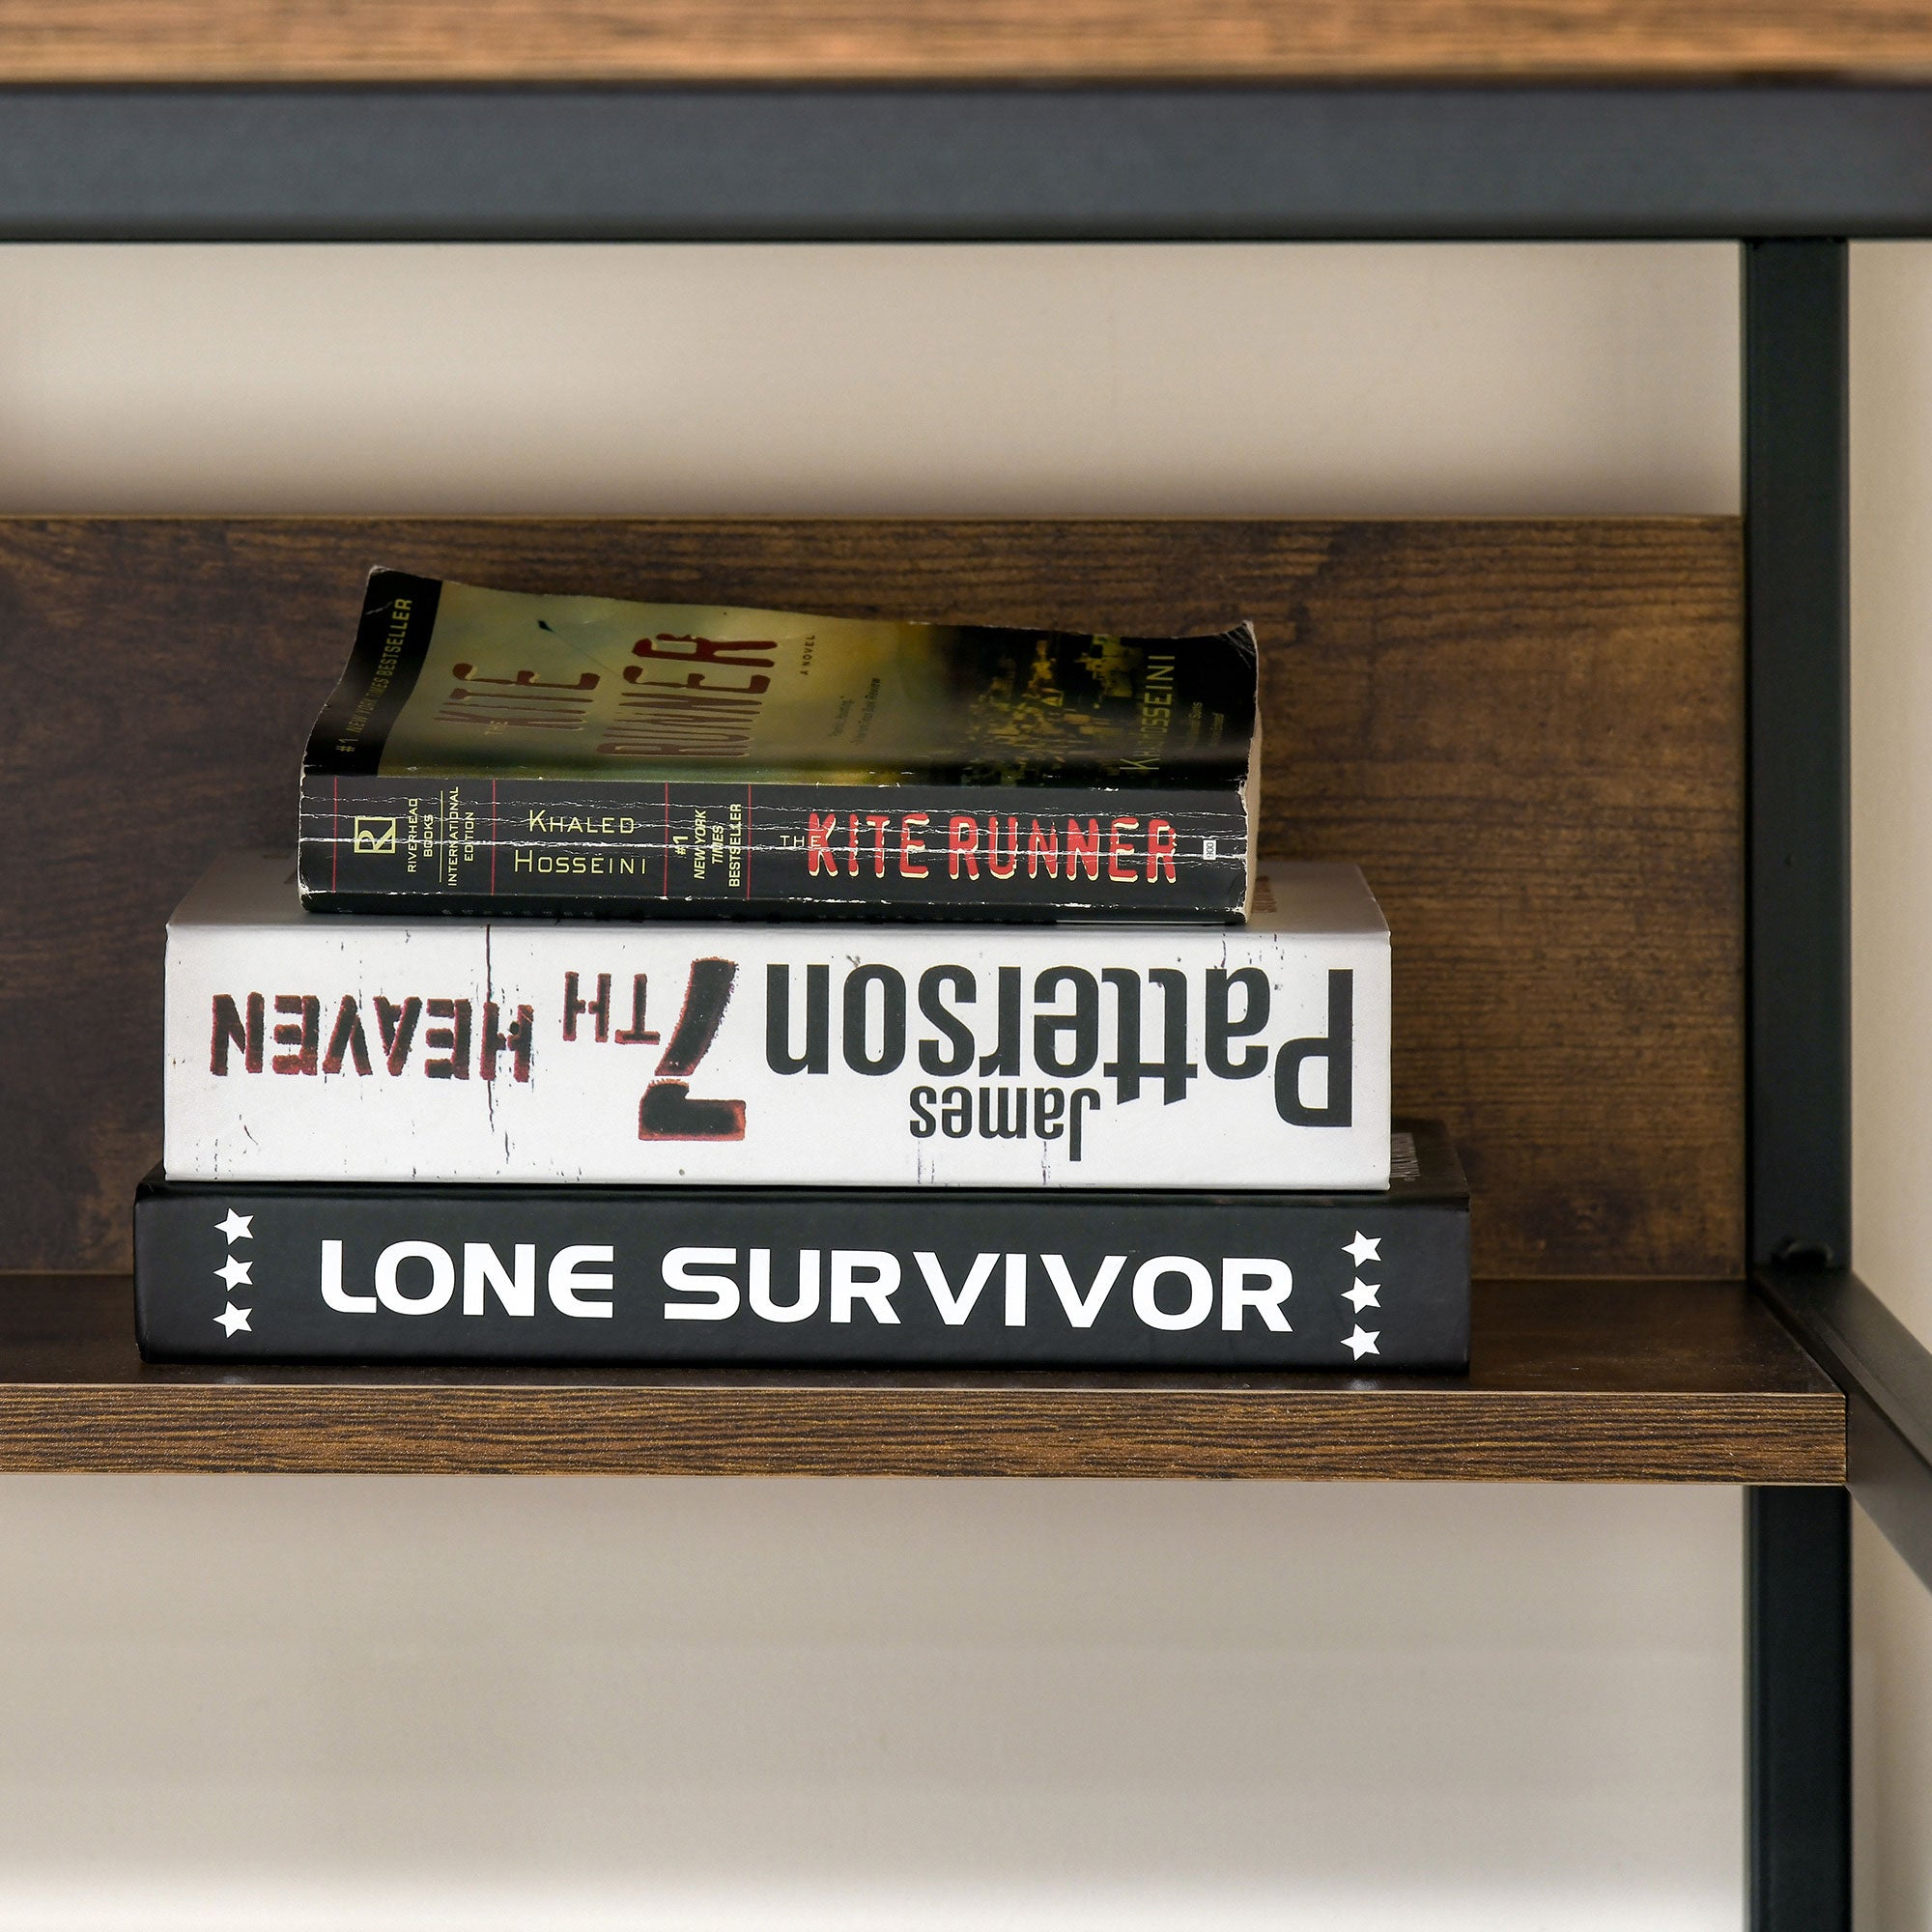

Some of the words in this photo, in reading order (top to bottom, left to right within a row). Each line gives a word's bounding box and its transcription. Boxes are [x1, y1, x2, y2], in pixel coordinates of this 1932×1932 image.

[376, 598, 413, 677] BESTSELLER
[802, 635, 815, 667] NOVEL
[355, 696, 379, 715] YORK
[434, 663, 601, 732] KITE
[595, 633, 778, 757] RUNNER
[335, 737, 358, 753] #1
[346, 713, 369, 733] NEW
[408, 798, 418, 873] RIVERHEAD
[423, 813, 434, 858] BOOKS
[447, 786, 459, 887] INTERNATIONAL
[465, 811, 474, 862] EDITION
[529, 810, 635, 834] KHALED
[672, 835, 689, 856] #1
[695, 809, 707, 843] YORK
[712, 824, 724, 864] TIMES
[728, 803, 742, 888] BESTSELLER
[515, 849, 645, 874] HOSSEINI
[694, 847, 706, 880] NEW
[780, 835, 822, 849] THE
[808, 812, 929, 878] KITE
[949, 815, 1178, 884] RUNNER
[210, 992, 534, 1083] HEAVEN
[765, 964, 1353, 1128] Patterson
[909, 1086, 1100, 1162] James
[322, 1239, 614, 1320] LONE
[662, 1246, 1293, 1333] SURVIVOR
